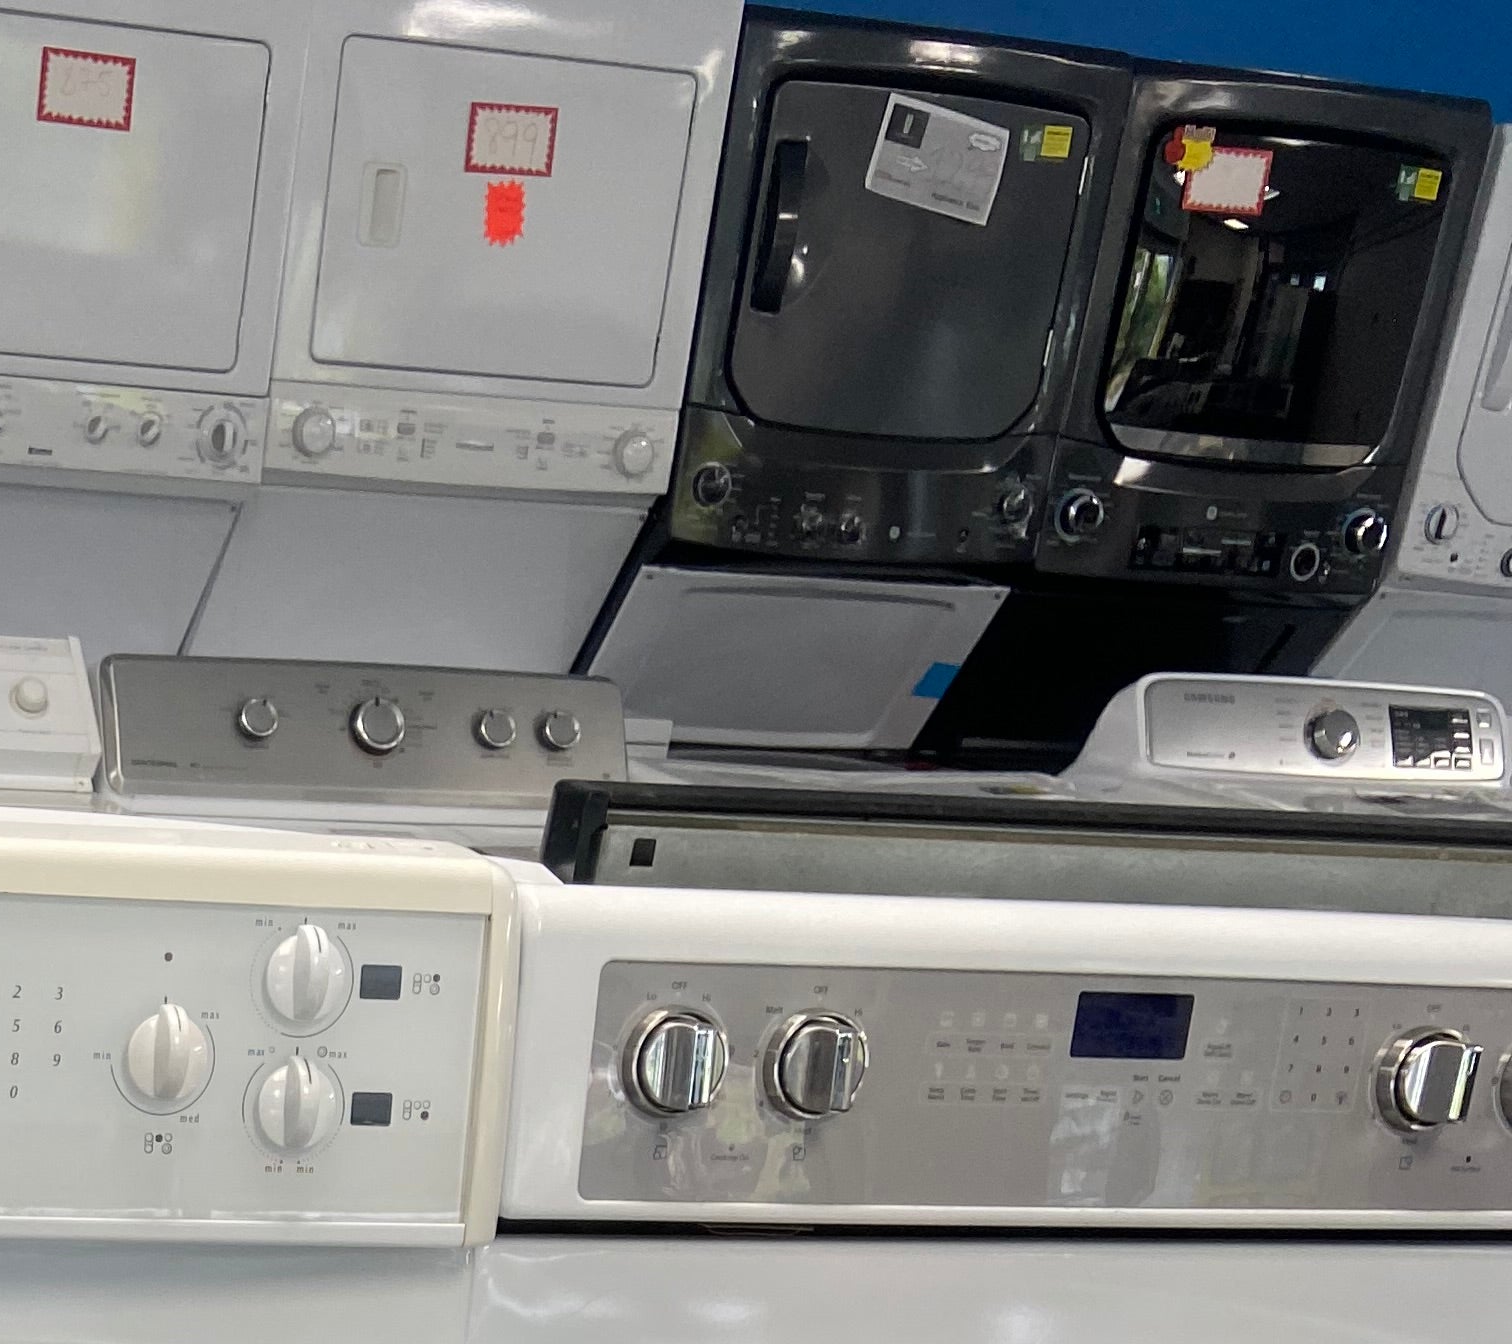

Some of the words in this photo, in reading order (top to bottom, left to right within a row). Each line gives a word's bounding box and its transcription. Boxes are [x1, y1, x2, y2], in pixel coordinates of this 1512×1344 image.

[255, 916, 274, 927] min
[337, 922, 356, 930] max
[12, 984, 22, 999] 2
[55, 986, 64, 1000] 3
[201, 1011, 220, 1020] max
[12, 1018, 21, 1033] 5
[54, 1020, 62, 1034] 6
[93, 1051, 112, 1060] min
[247, 1048, 265, 1056] max
[328, 1051, 347, 1059] max
[10, 1052, 19, 1066] 8
[53, 1053, 61, 1067] 9
[9, 1085, 18, 1099] 0
[179, 1114, 200, 1123] med
[264, 1164, 283, 1173] min
[296, 1165, 314, 1174] min
